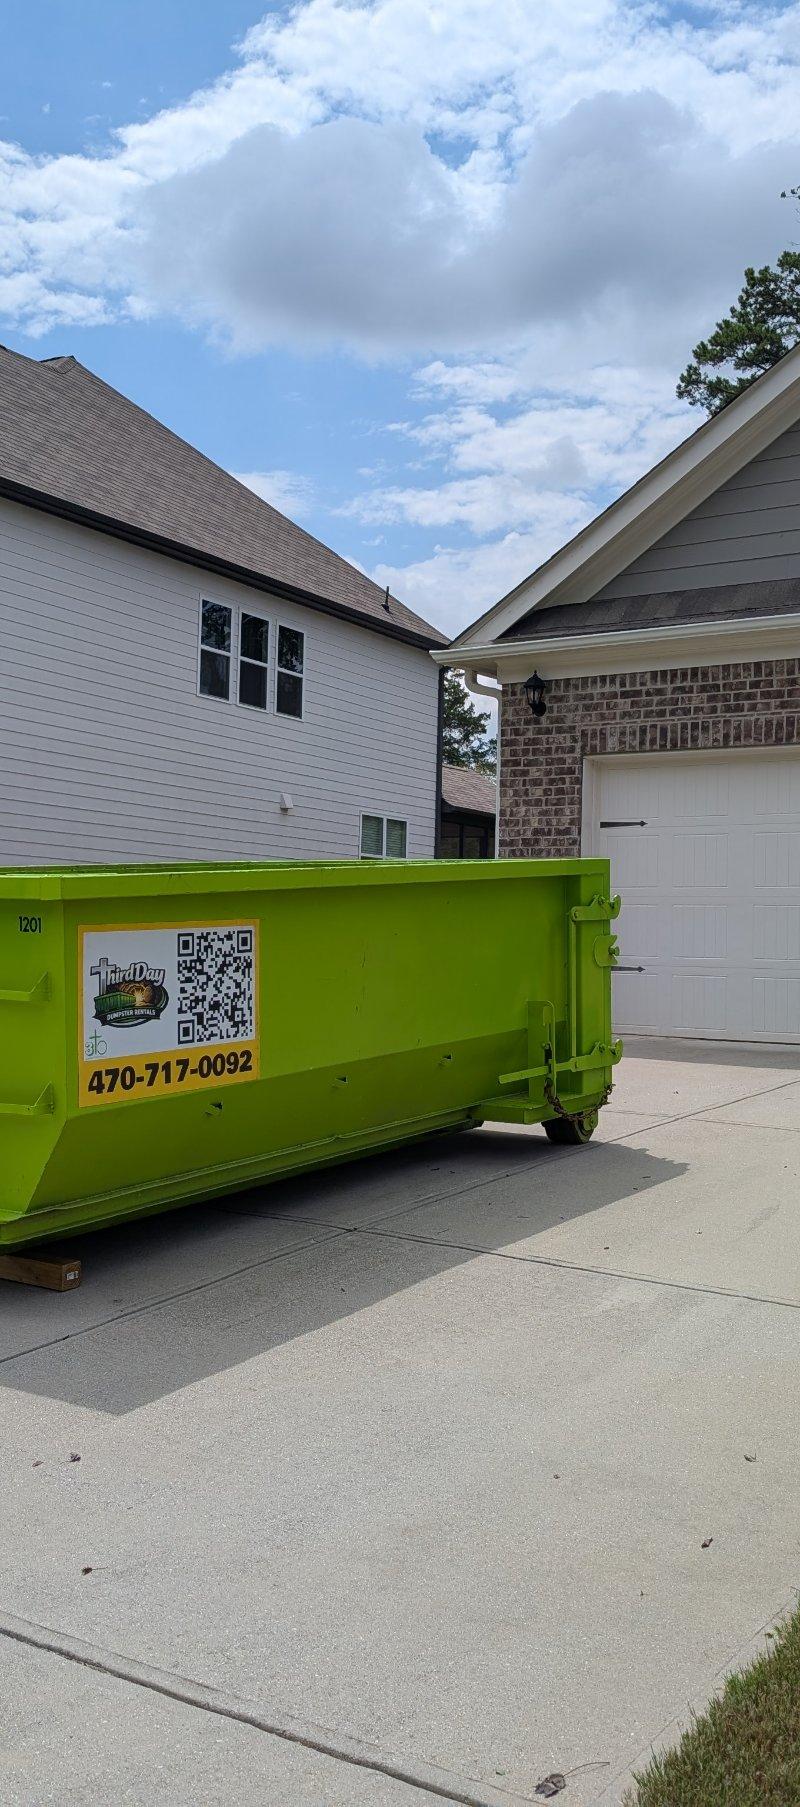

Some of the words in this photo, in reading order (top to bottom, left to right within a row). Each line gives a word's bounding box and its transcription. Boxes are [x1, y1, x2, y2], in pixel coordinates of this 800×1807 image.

[19, 916, 42, 934] 1201
[106, 1010, 134, 1021] DUMPSTER
[134, 1009, 156, 1017] RENTALS
[88, 1050, 252, 1094] 470-717-0092
